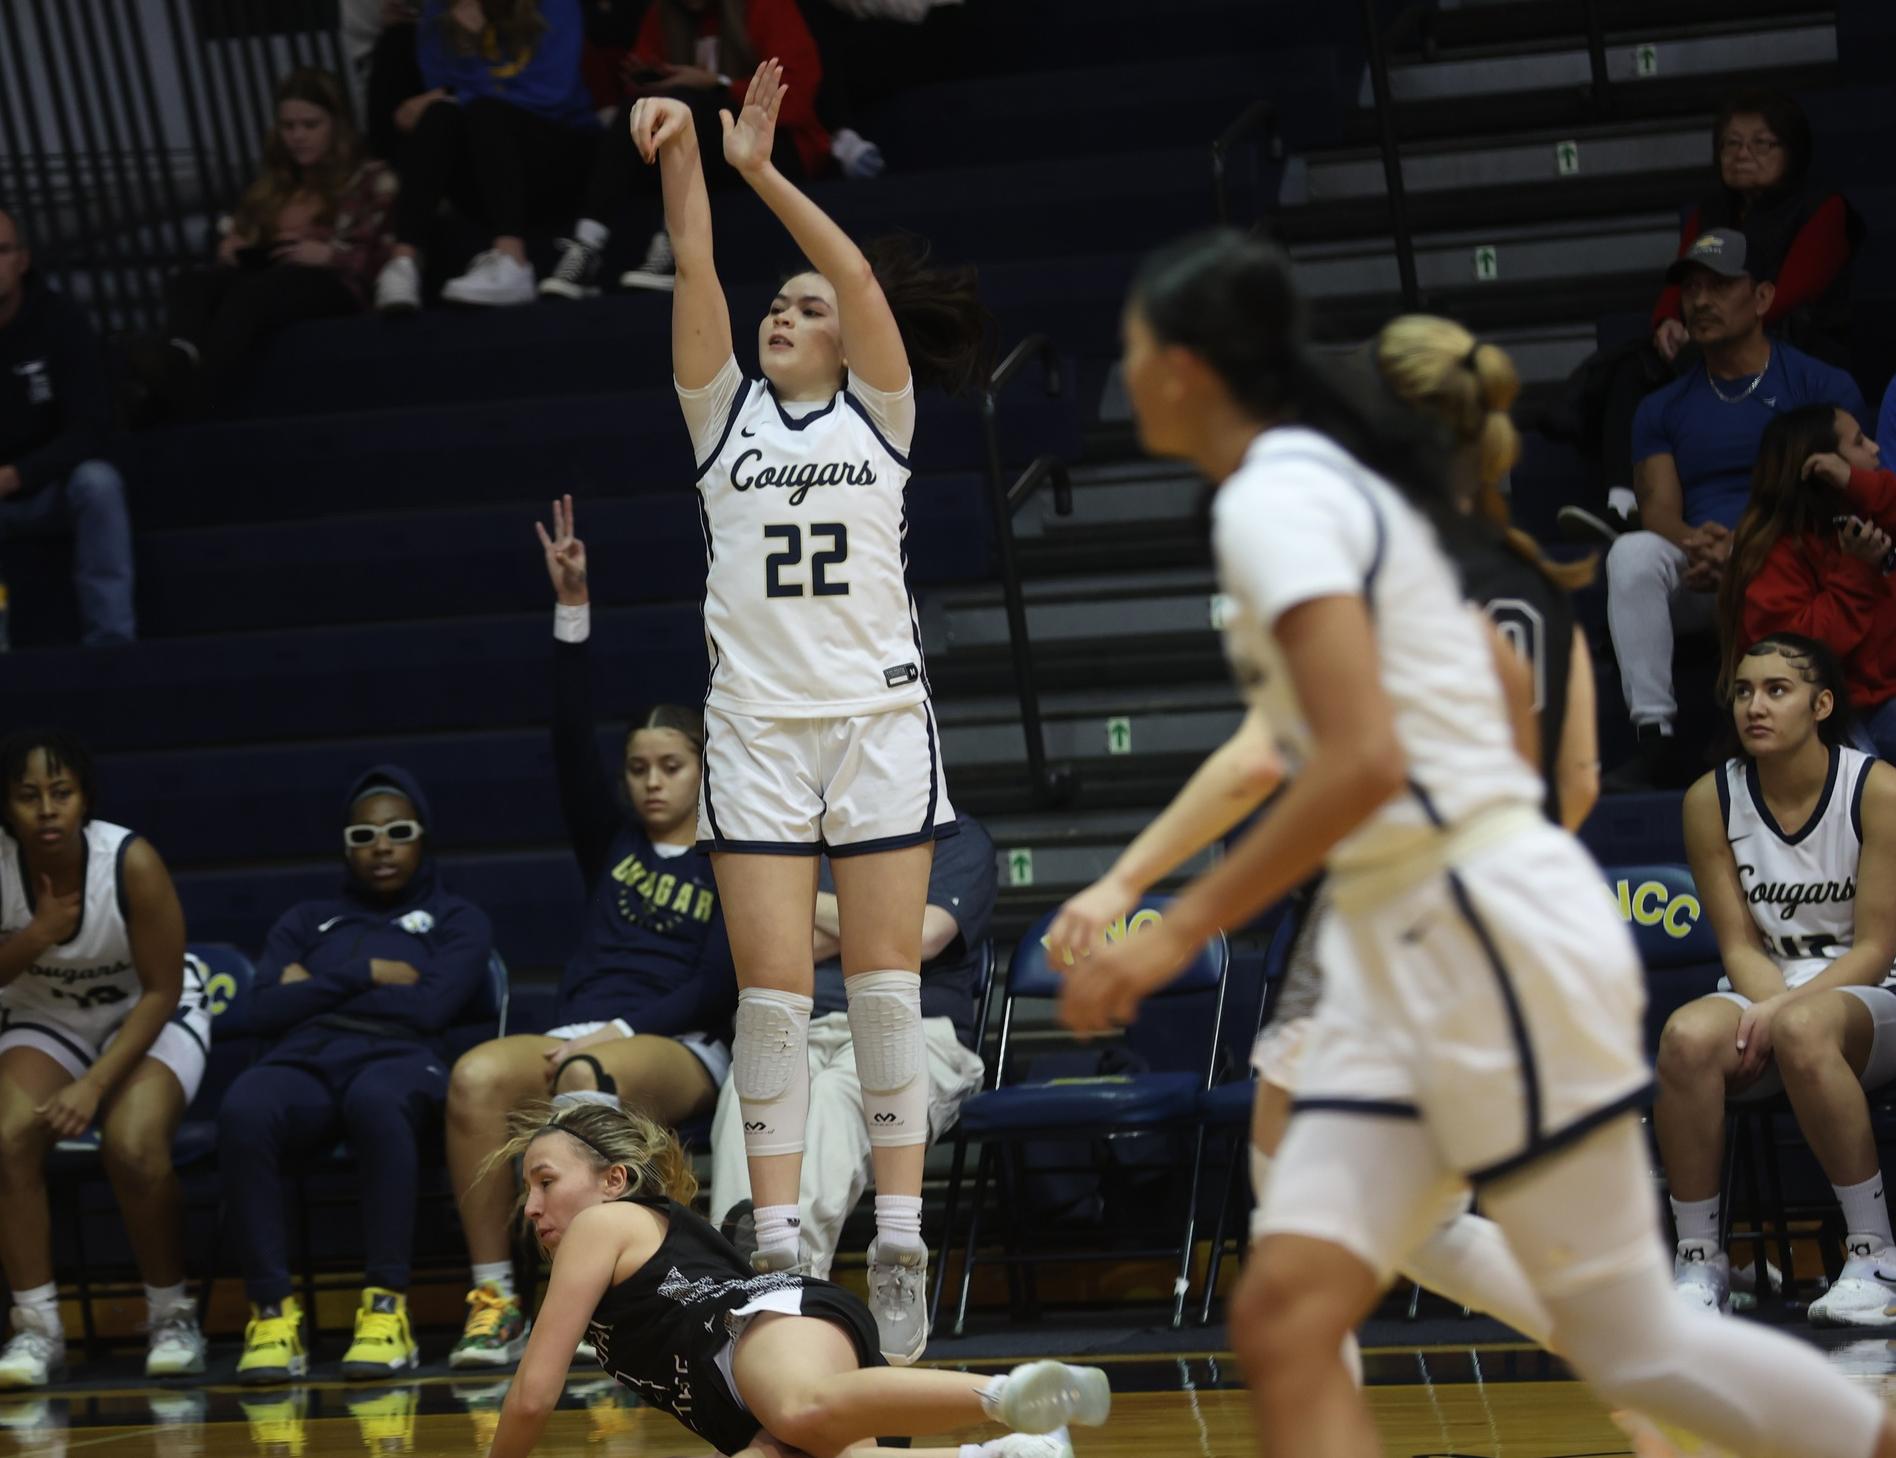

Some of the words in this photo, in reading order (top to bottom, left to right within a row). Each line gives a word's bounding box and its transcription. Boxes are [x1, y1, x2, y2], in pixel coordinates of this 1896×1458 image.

[730, 448, 877, 506] Cougars
[763, 522, 850, 598] 22
[28, 960, 133, 985] ougars
